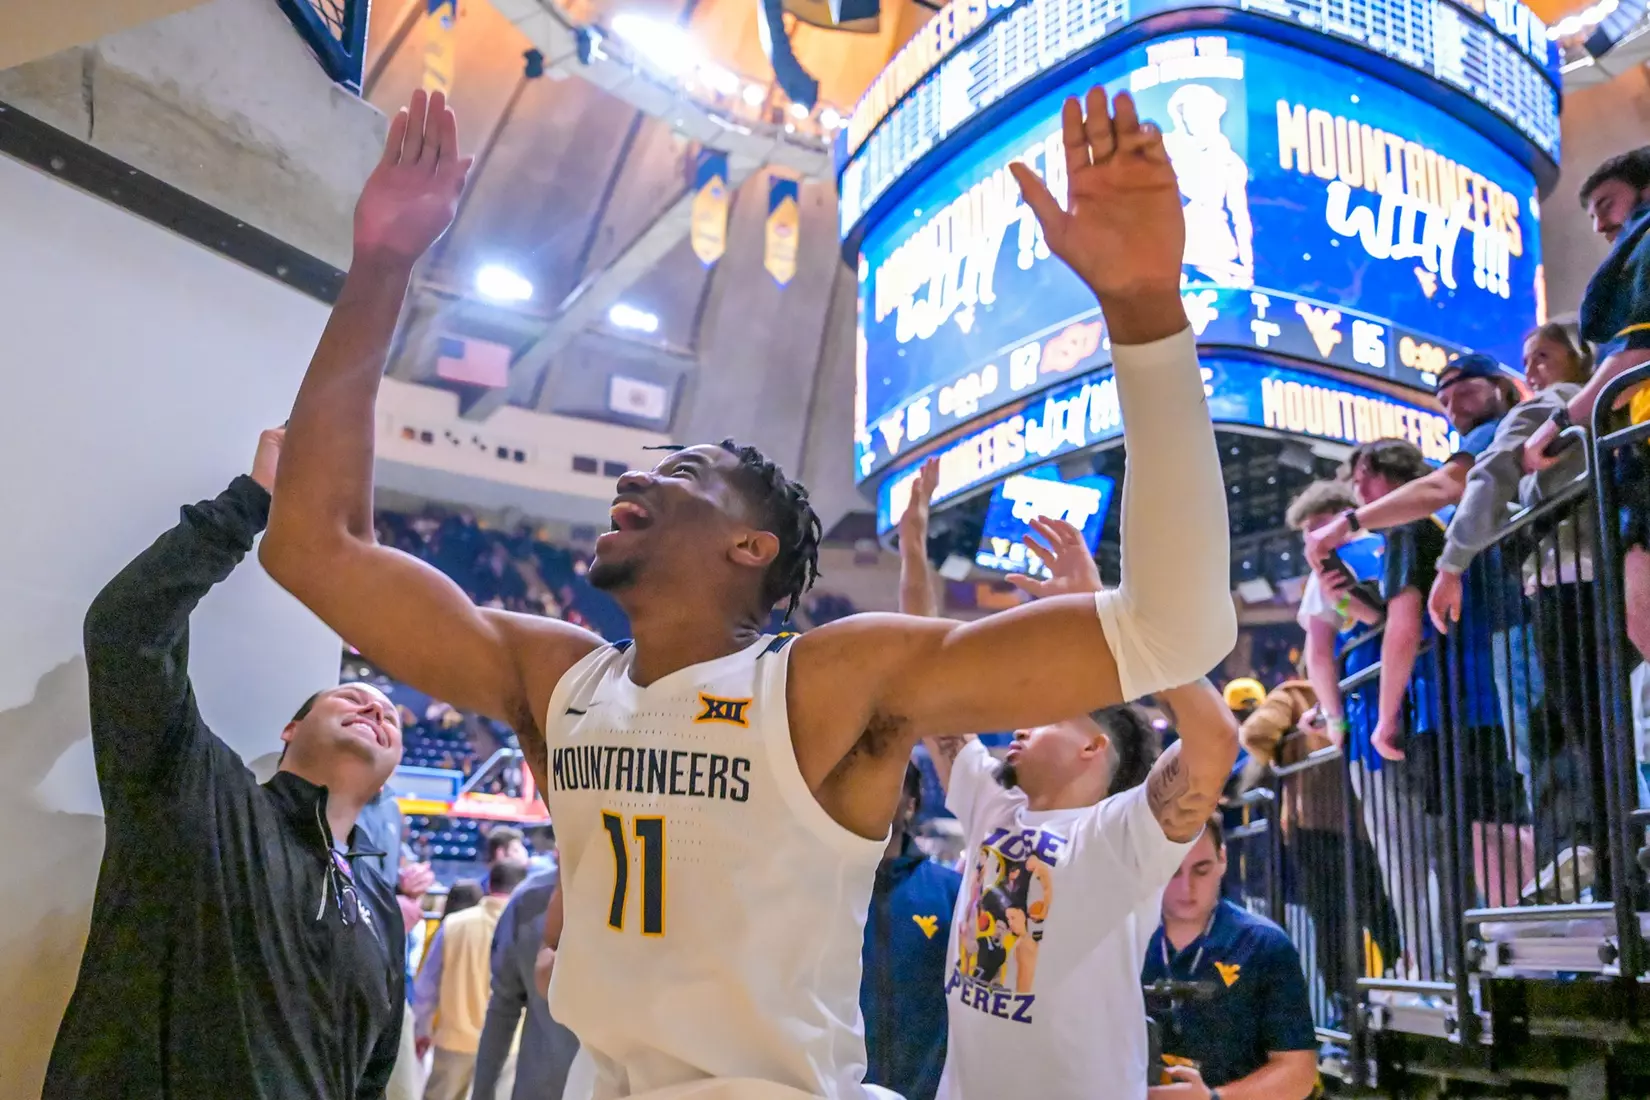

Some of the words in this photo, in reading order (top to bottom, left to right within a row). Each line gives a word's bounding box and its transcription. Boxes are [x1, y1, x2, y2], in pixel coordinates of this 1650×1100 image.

[1276, 98, 1523, 257] MOUNTAINEERS
[1261, 378, 1450, 463] MOUNTAINEERS
[552, 745, 751, 803] MOUNTAINEERS
[601, 808, 666, 938] 11
[945, 964, 1036, 1025] PEREZ
